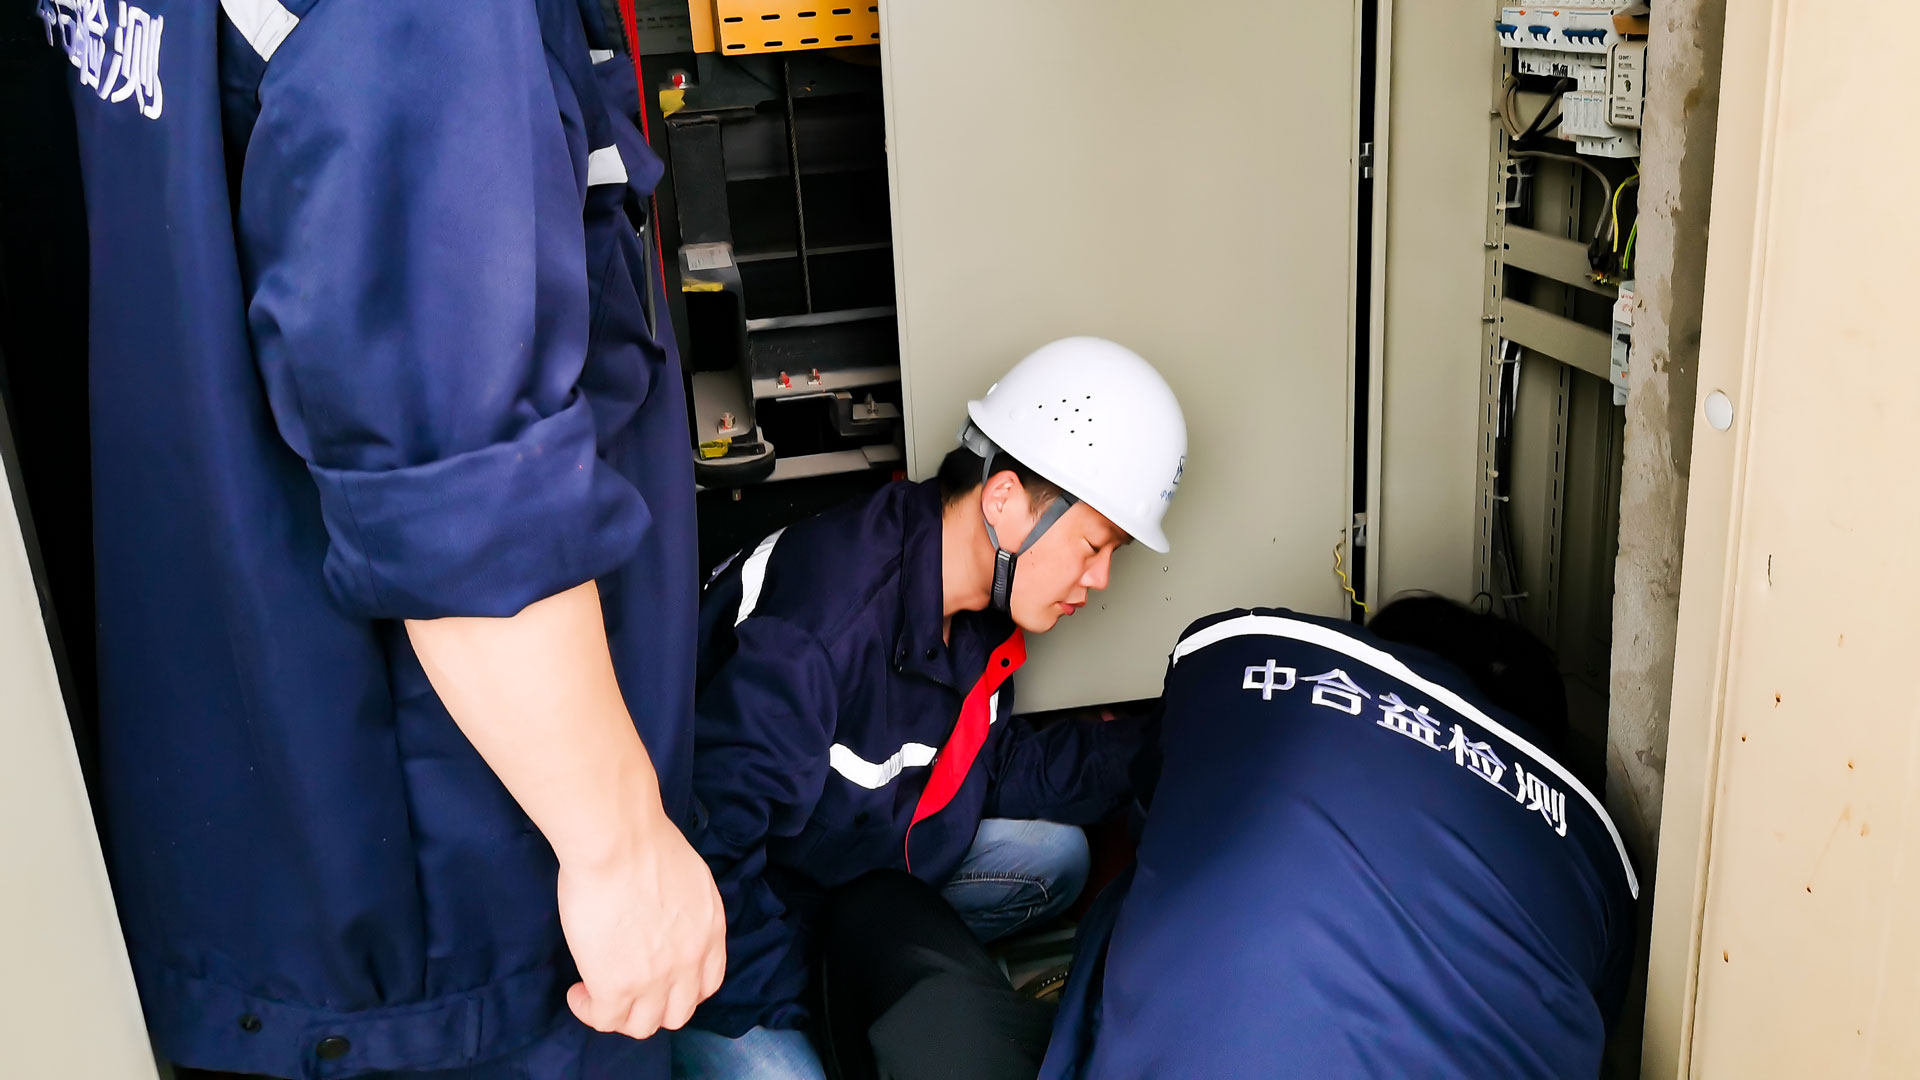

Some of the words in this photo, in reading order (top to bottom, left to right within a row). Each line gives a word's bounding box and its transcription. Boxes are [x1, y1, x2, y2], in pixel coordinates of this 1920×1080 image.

[1242, 659, 1568, 838] 中合益检测
